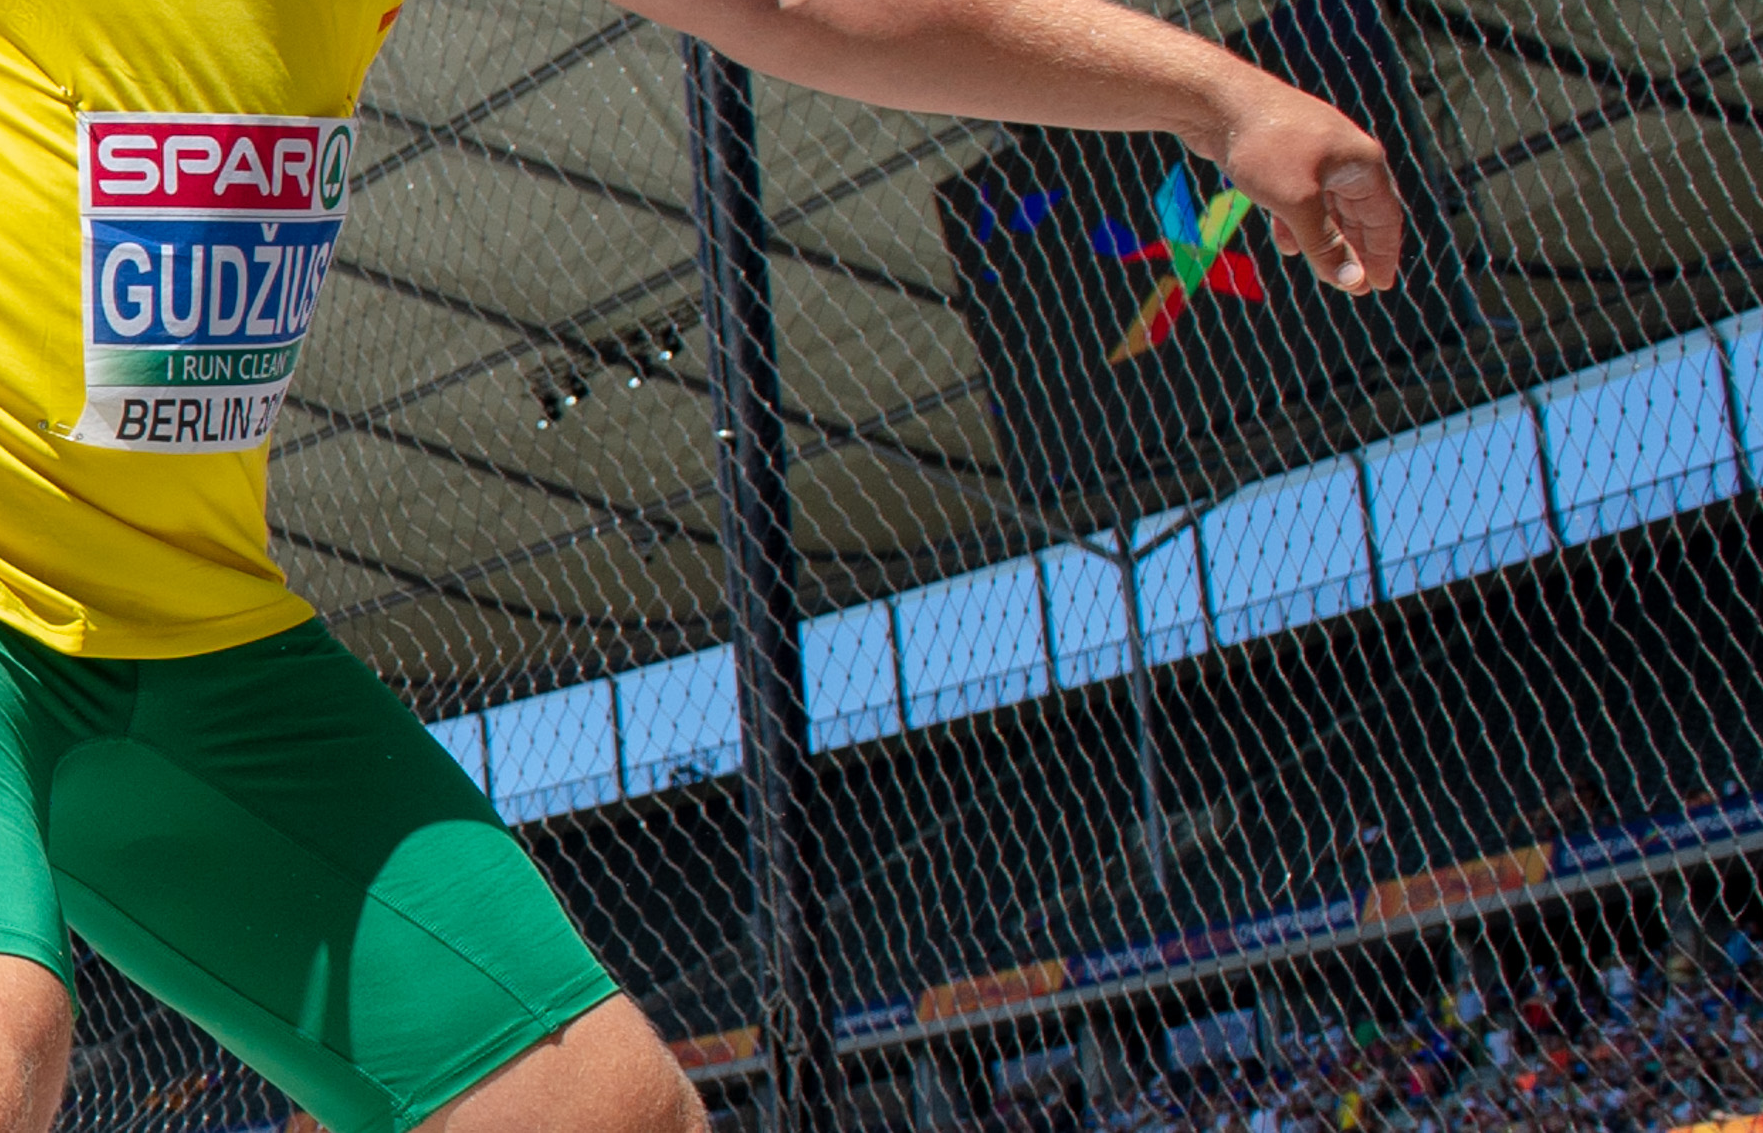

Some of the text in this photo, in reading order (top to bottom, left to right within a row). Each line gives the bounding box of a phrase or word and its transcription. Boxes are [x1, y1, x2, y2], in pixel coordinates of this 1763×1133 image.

[98, 134, 313, 197] SPAR
[101, 223, 330, 337] GUDŽIUS
[167, 352, 287, 381] I RUN CLEAN
[116, 399, 253, 442] BERLIN
